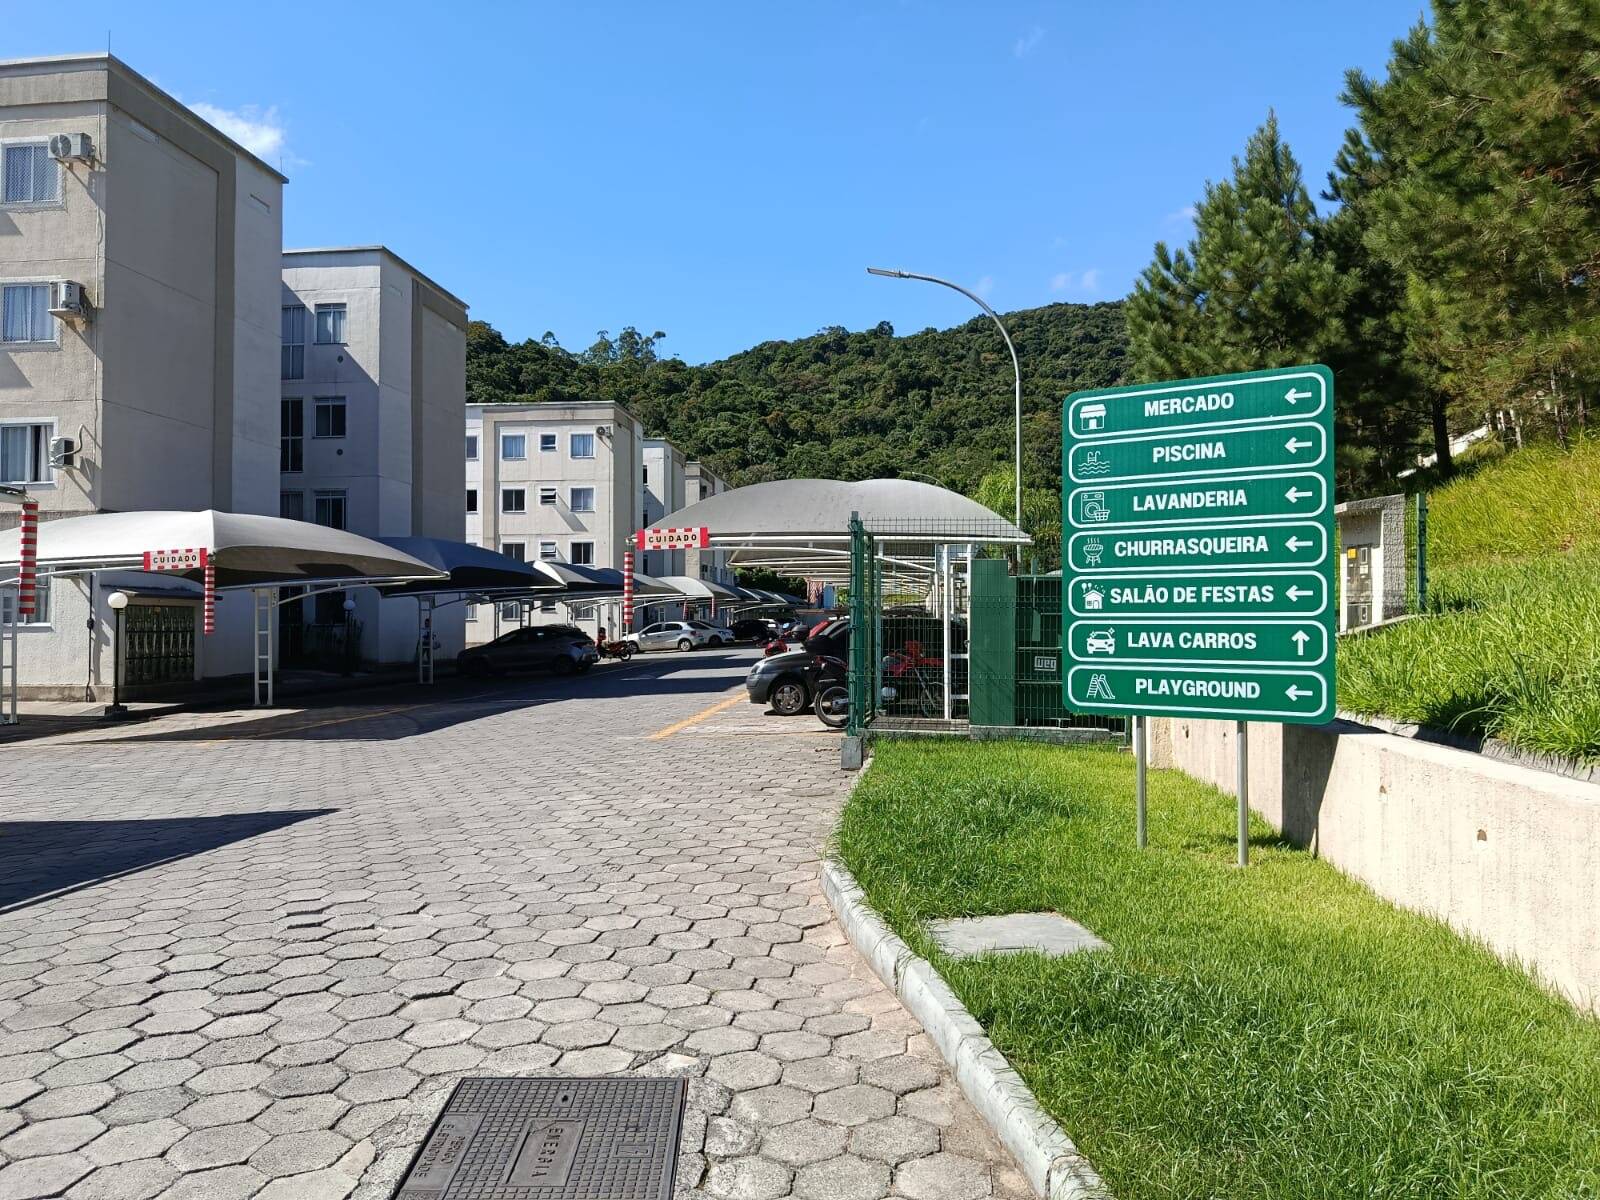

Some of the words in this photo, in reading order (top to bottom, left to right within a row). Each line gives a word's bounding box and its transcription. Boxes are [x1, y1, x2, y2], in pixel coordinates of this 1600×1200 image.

[1144, 392, 1235, 417] MERCADO
[1153, 442, 1226, 463] PISCINA
[1133, 489, 1248, 512] LAVANDERIA
[648, 533, 697, 543] CUIDADO
[1114, 536, 1269, 557] CHURRASQUEIRA
[153, 554, 197, 564] CUIDADO
[1110, 584, 1169, 604] SALÃO
[1174, 587, 1196, 603] DE
[1202, 586, 1274, 603] FESTAS
[1127, 632, 1175, 649] LAVA
[1179, 632, 1257, 650] CARROS
[1136, 678, 1261, 699] PLAYGROUND
[413, 1122, 456, 1178] ELETRICIDADE
[439, 1135, 466, 1165] PERIGO
[531, 1126, 564, 1178] ENERGIA
